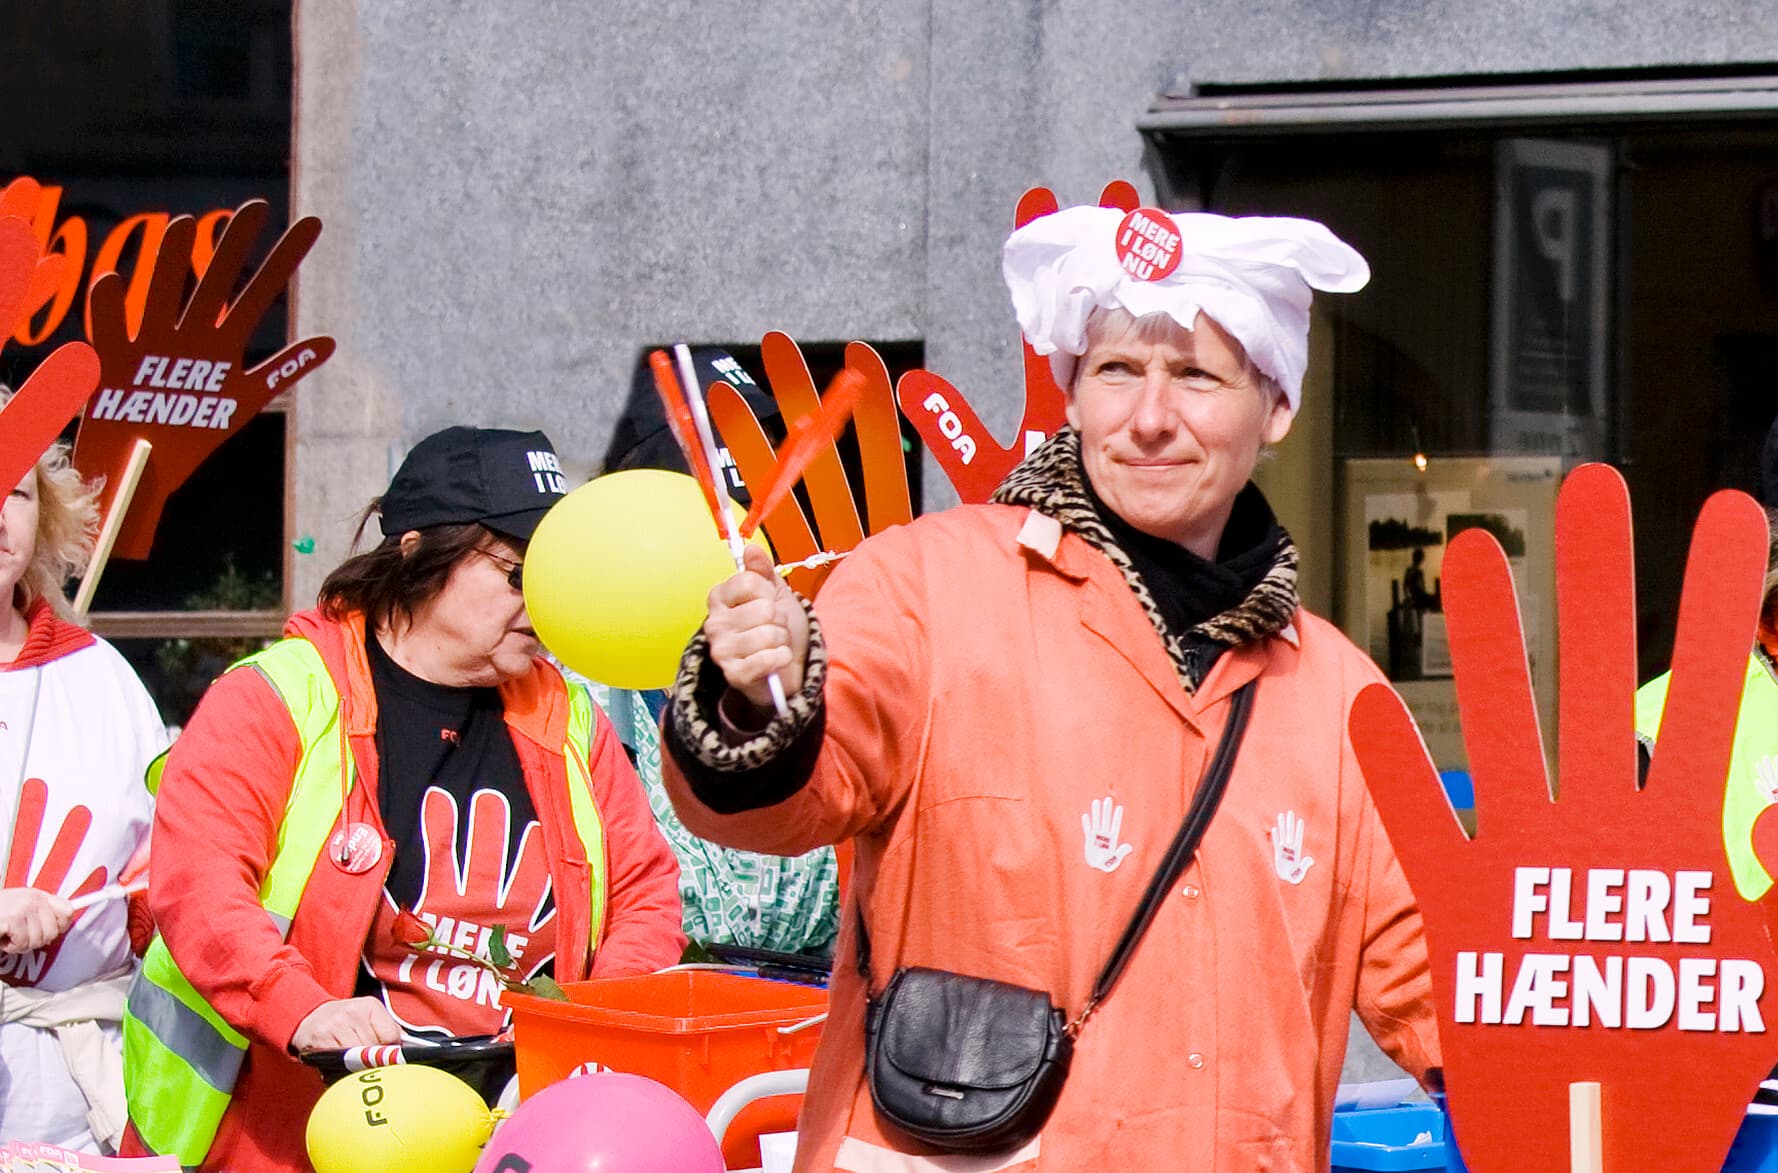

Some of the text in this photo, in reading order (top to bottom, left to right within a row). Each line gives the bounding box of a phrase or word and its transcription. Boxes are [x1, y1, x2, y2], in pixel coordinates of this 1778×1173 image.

[1120, 229, 1171, 269] I LØN
[1128, 212, 1180, 253] MERE
[1122, 251, 1155, 280] NU
[133, 355, 232, 392] FLERE
[266, 348, 317, 389] FOA
[92, 389, 237, 429] HÆNDER
[923, 392, 976, 465] FOA
[1512, 867, 1713, 944] FLERE
[399, 954, 418, 983] I
[1454, 951, 1767, 1034] HÆNDER
